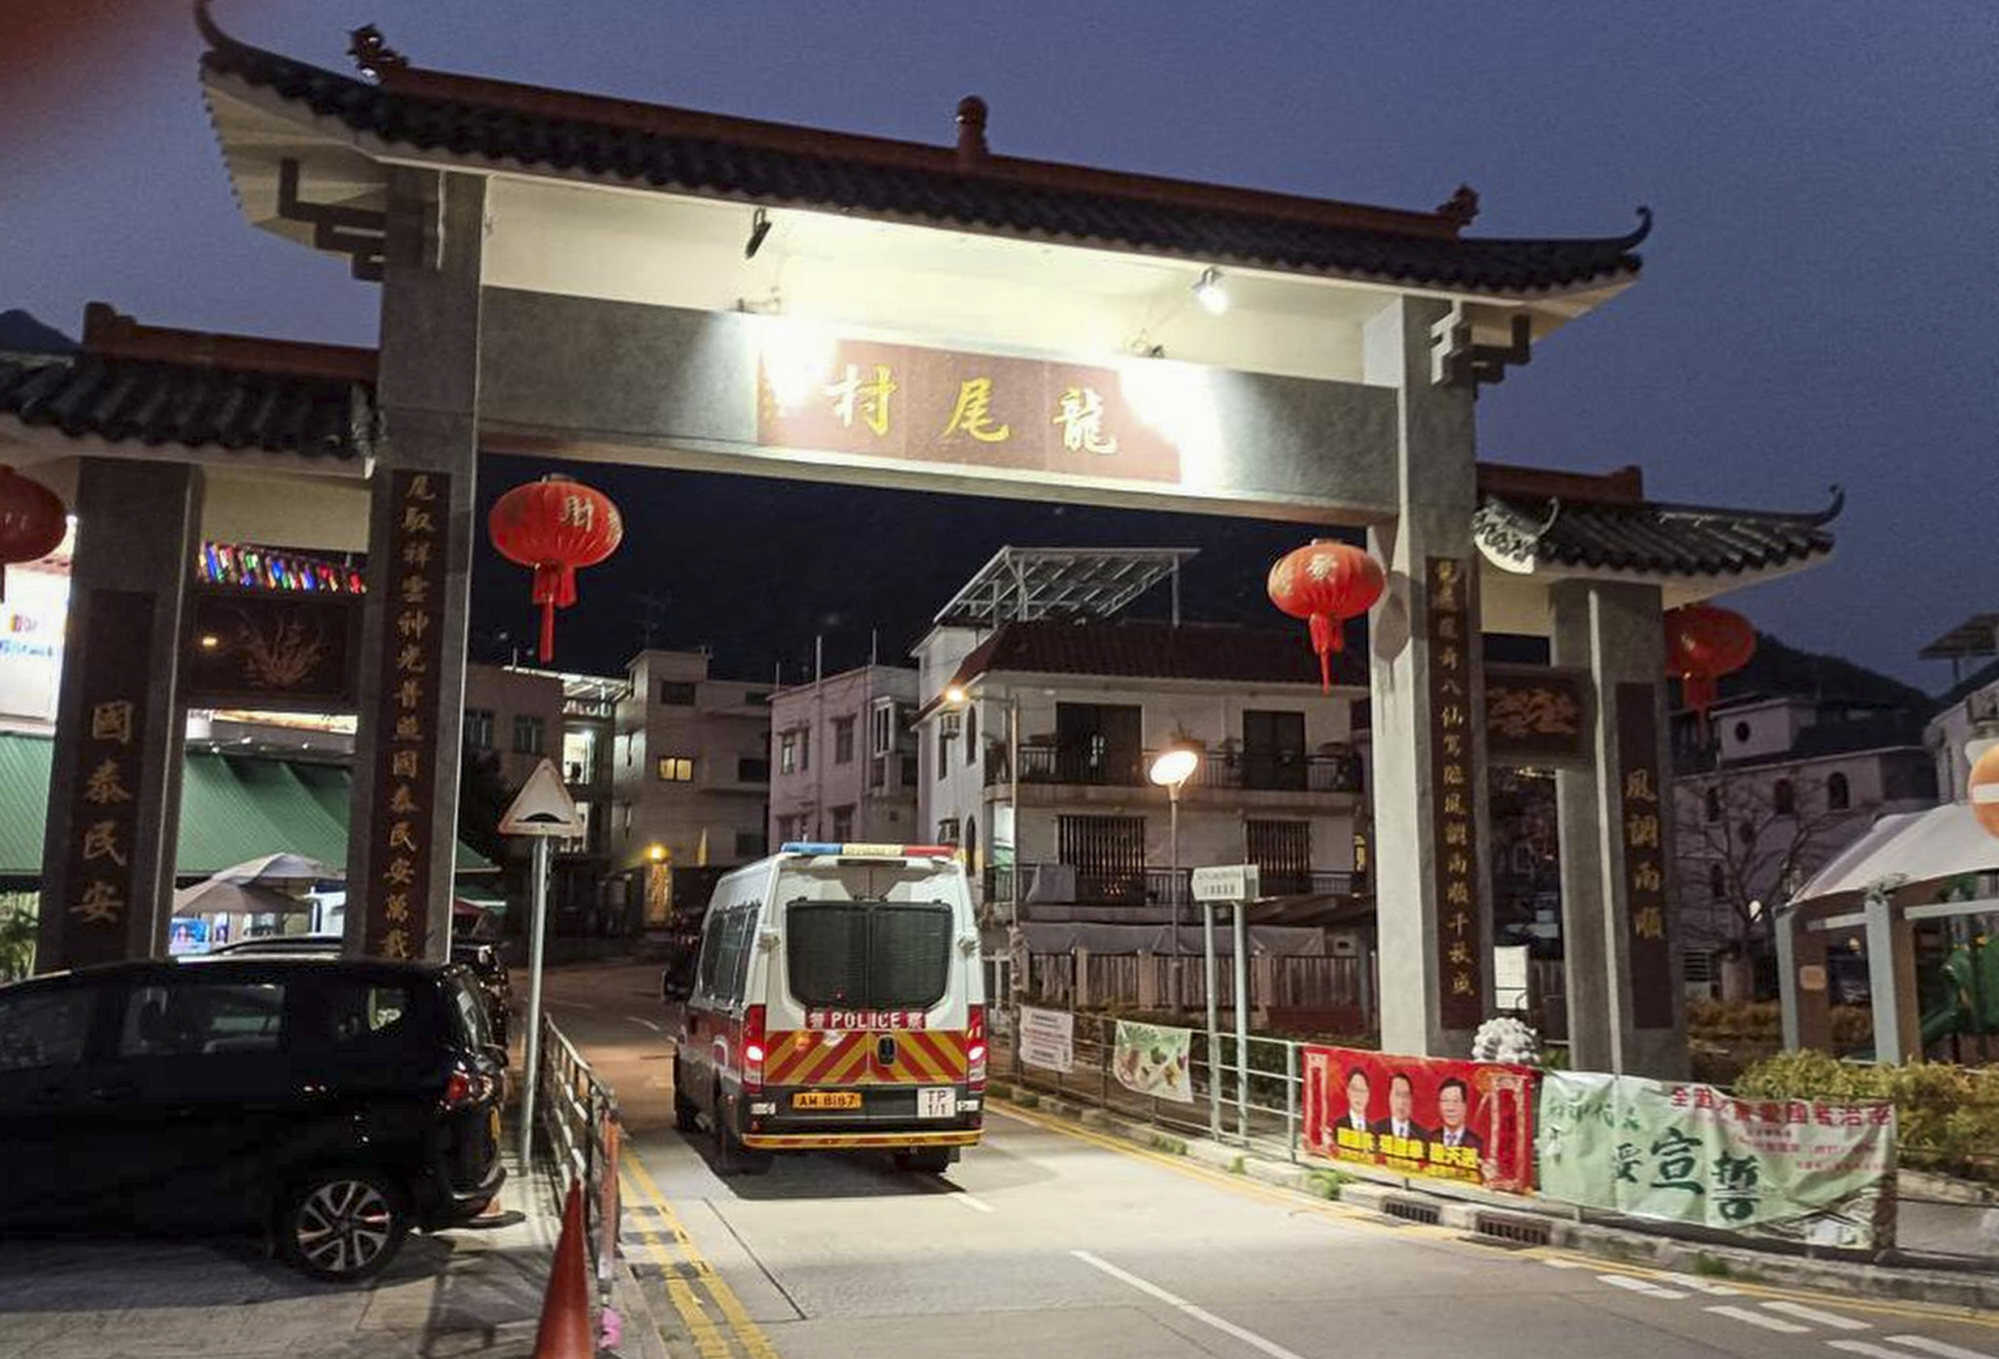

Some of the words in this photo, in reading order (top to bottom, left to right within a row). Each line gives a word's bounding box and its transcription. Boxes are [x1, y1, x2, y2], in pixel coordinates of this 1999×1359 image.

[824, 364, 1119, 455] 龍尾村
[69, 700, 134, 923] 國泰民安
[831, 1012, 900, 1029] POLICE
[800, 1095, 817, 1106] AM
[926, 1090, 946, 1102] TP
